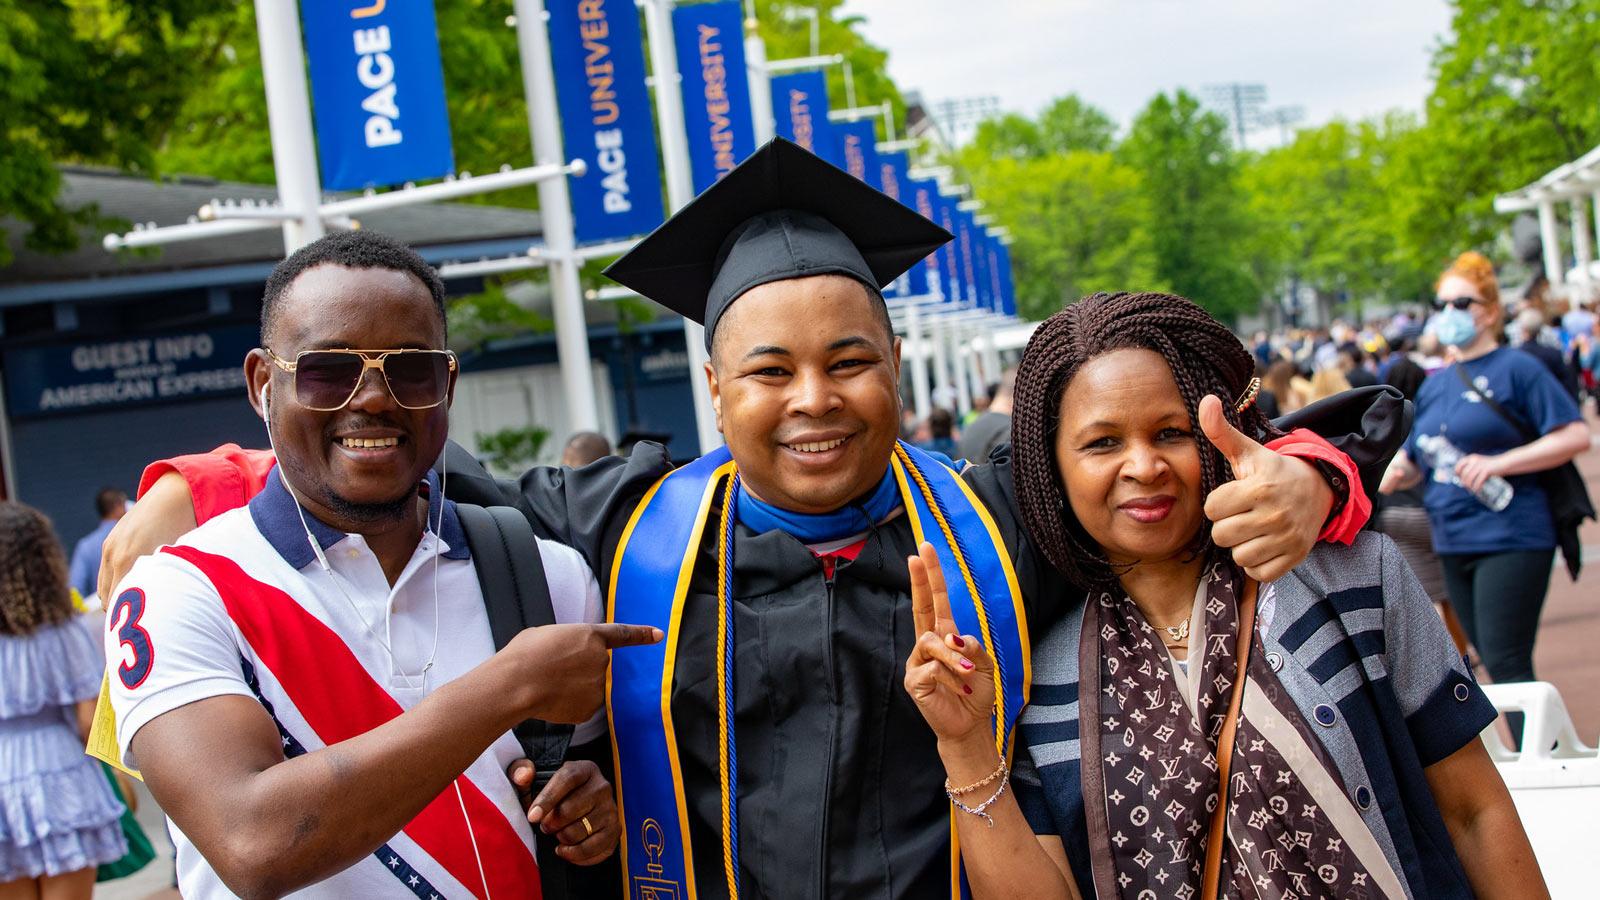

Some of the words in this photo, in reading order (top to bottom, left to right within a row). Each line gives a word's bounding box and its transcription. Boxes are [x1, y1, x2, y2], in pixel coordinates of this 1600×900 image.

[353, 25, 402, 148] PACE
[578, 0, 619, 126] UNIVER
[595, 127, 632, 214] PACE
[39, 379, 154, 410] AMERICAN
[157, 366, 246, 397] EXPRES
[71, 340, 151, 371] GUEST
[155, 333, 214, 360] INFO
[110, 587, 154, 690] 3
